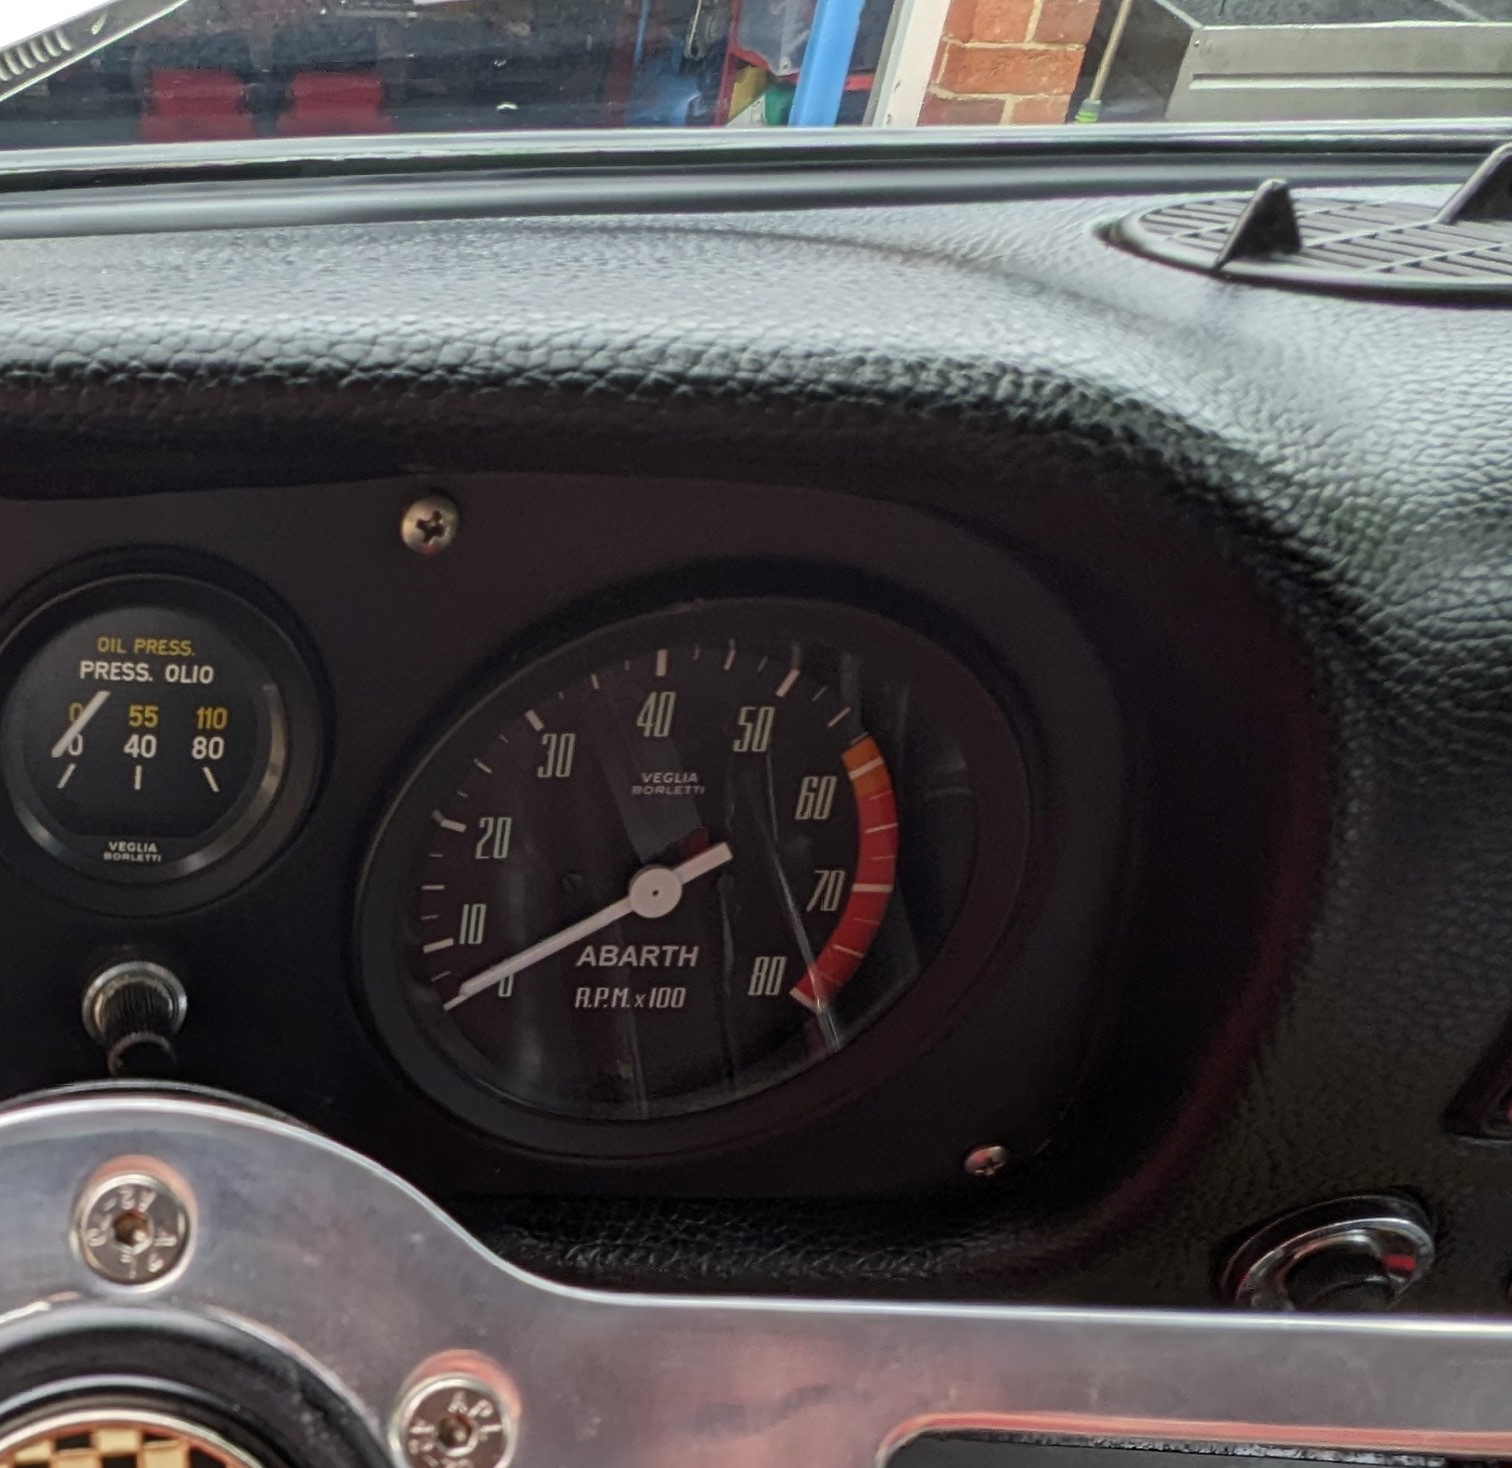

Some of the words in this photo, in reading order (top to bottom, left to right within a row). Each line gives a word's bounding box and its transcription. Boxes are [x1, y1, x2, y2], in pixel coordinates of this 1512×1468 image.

[97, 636, 127, 654] OIL
[134, 638, 195, 656] PRESS.
[79, 660, 153, 682] PRESS.
[164, 664, 214, 684] OLIO
[128, 705, 158, 728] 55
[196, 706, 228, 730] 110
[637, 691, 676, 737] 40
[733, 706, 775, 752] 50
[124, 735, 157, 759] 40
[191, 736, 224, 760] 80
[537, 733, 575, 777] 30
[631, 785, 705, 795] BORLETTI
[641, 772, 699, 784] VEGLIA
[795, 776, 837, 821] 60
[108, 841, 157, 853] VEGLIA
[475, 817, 512, 860] 20
[103, 852, 162, 863] BORLETTI
[806, 870, 846, 912] 70
[458, 904, 487, 945] 10
[576, 946, 700, 967] ABARTH
[748, 956, 787, 996] 80
